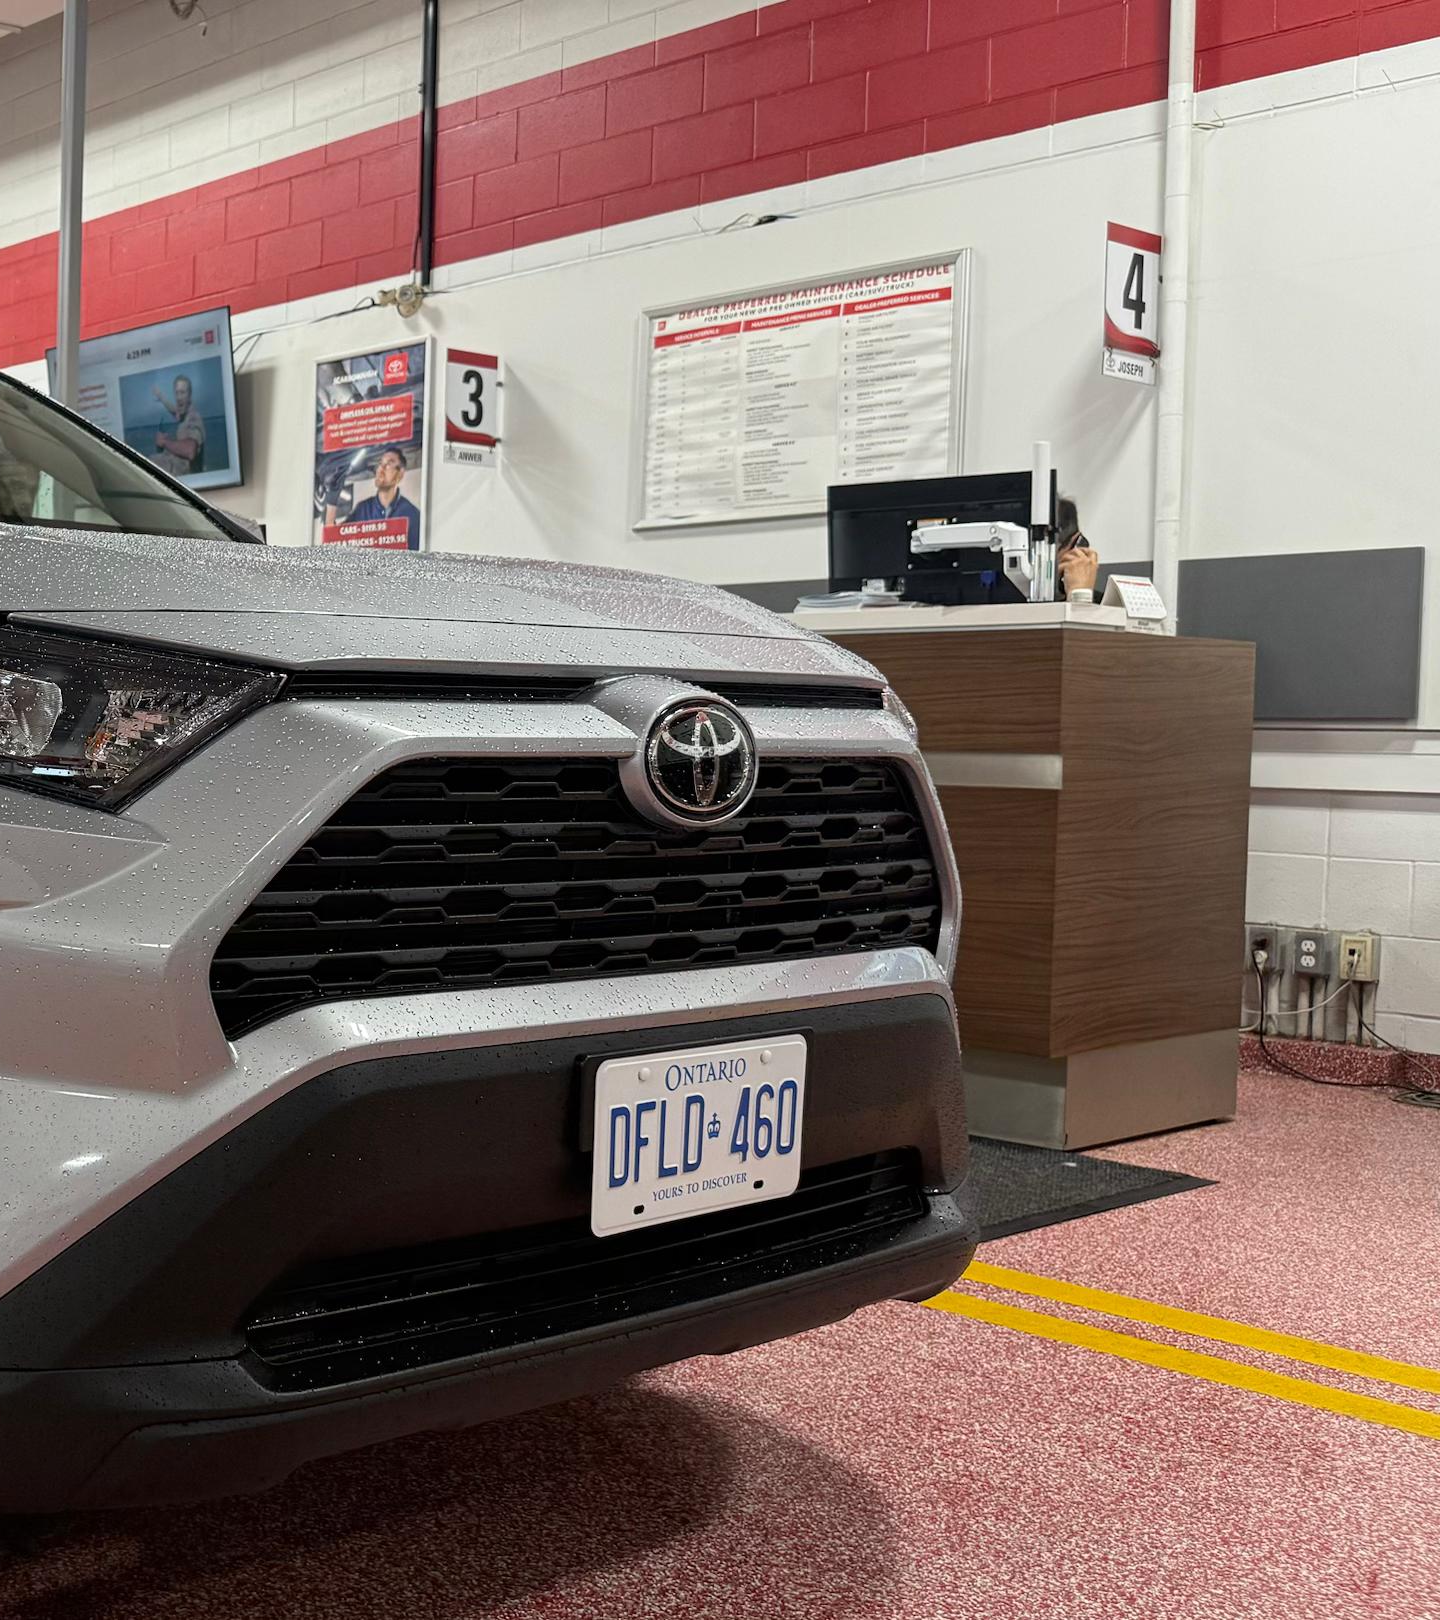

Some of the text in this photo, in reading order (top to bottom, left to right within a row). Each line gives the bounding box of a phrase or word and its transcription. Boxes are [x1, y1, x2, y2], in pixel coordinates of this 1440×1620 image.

[678, 263, 950, 320] DEALER PREFERRED MAINTENANCE SCHEDULE
[910, 291, 940, 303] SERVICES
[1122, 252, 1146, 330] 4
[720, 311, 737, 320] YOUR
[740, 308, 757, 316] NEW
[784, 300, 811, 310] OWNED
[813, 293, 843, 304] VEHICLE
[1117, 360, 1144, 377] JOSEPH
[461, 369, 484, 428] 3
[457, 451, 482, 463] ANWER
[339, 525, 358, 535] CARS
[665, 1057, 747, 1092] ONTARIO
[608, 1078, 799, 1189] DFLD 460
[651, 1172, 748, 1202] YOURS TO DISCOVER
